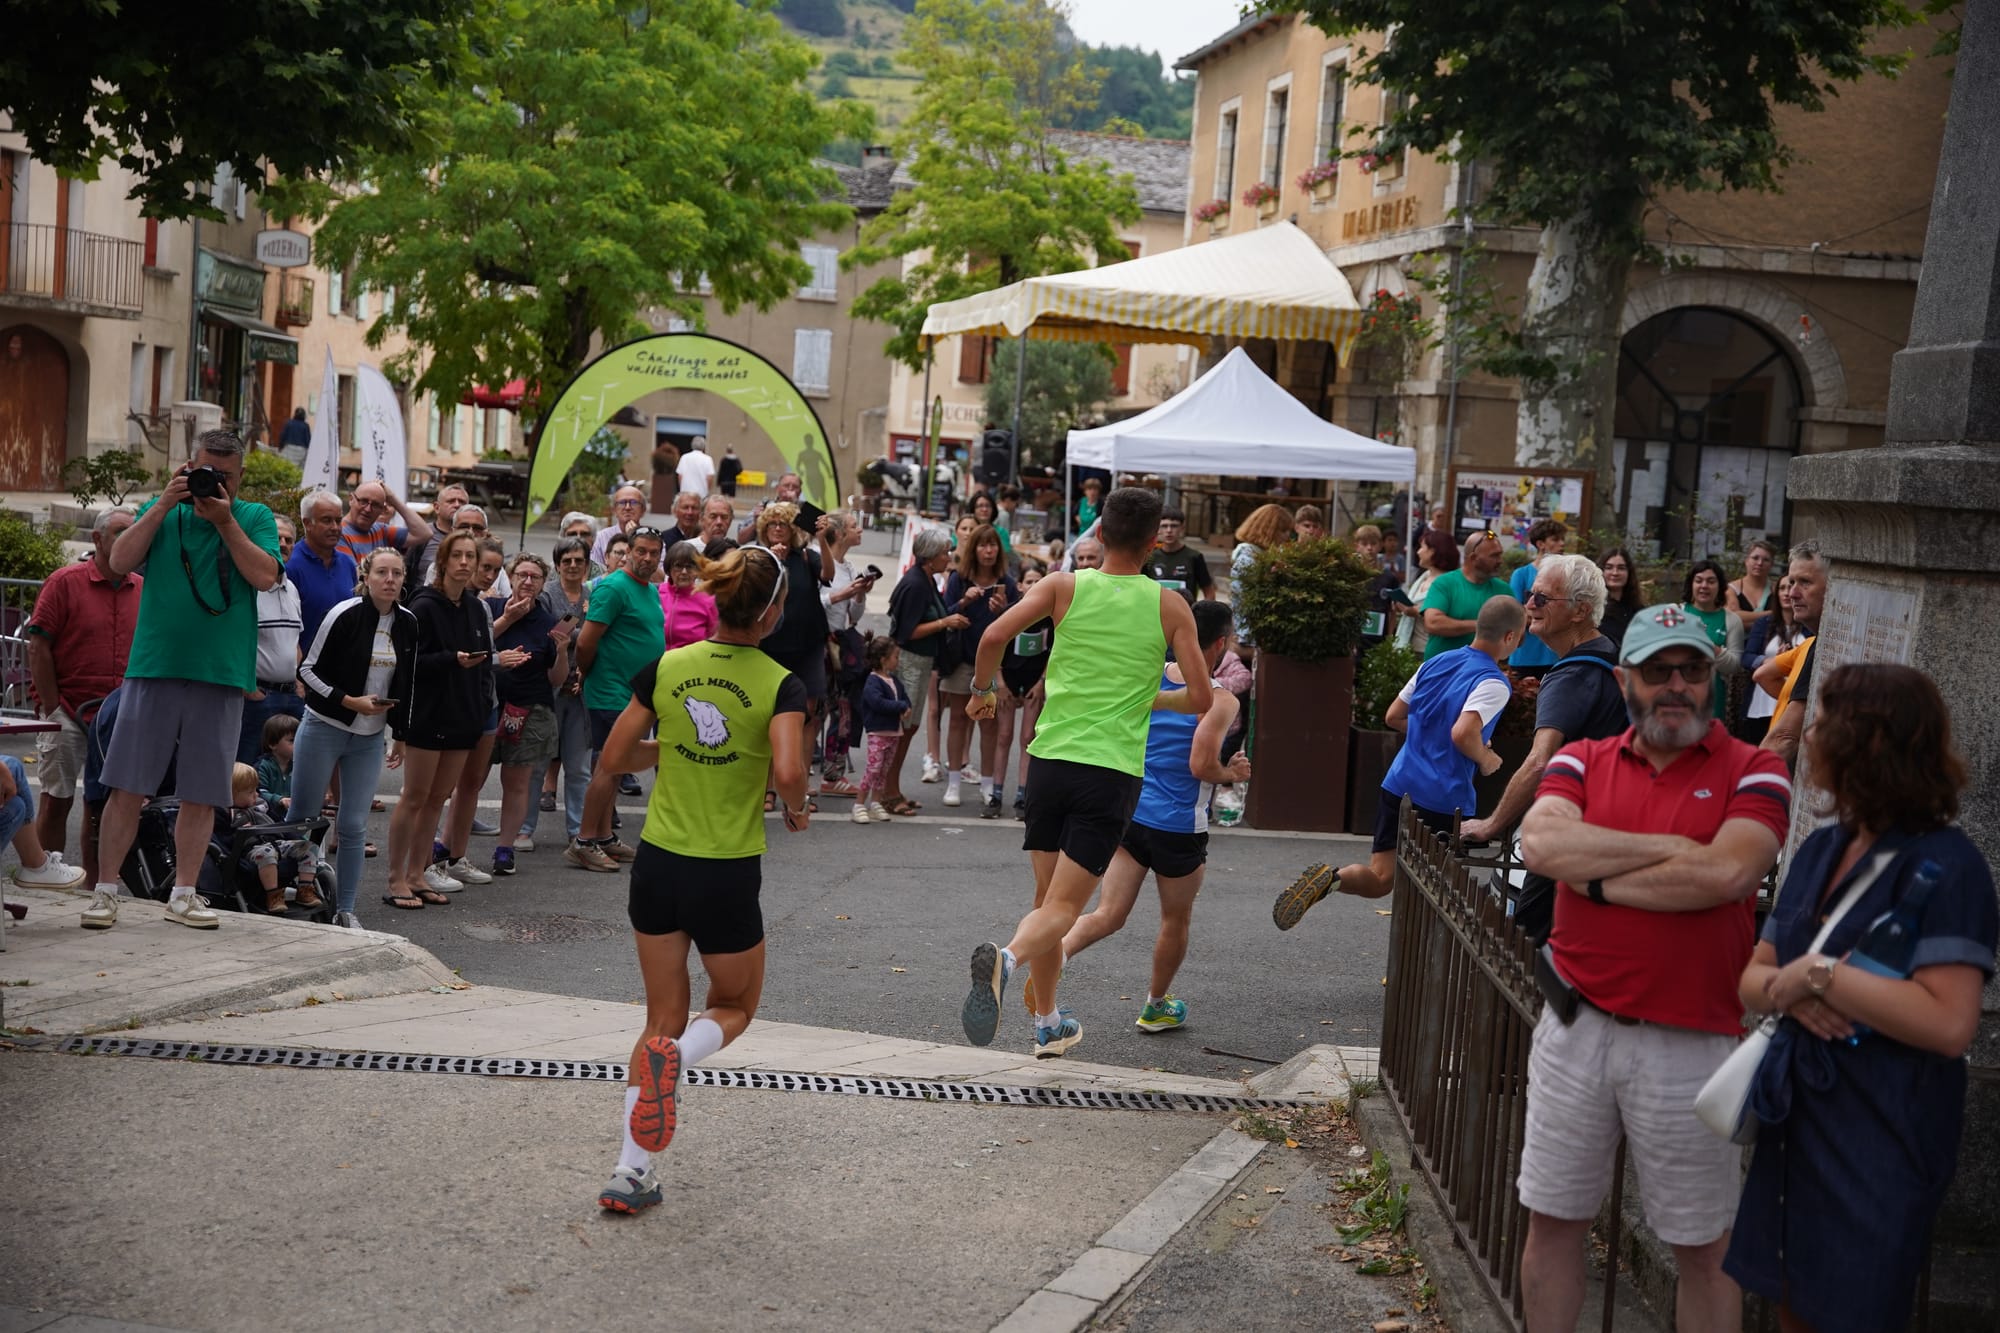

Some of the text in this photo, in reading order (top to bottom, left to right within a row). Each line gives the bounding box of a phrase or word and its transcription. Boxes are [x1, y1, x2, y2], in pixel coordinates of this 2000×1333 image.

[1342, 195, 1417, 239] MAIRIE
[262, 239, 304, 259] PIZZERIA
[636, 350, 741, 369] Challenge des
[626, 364, 678, 377] vallées
[1028, 641, 1037, 650] 2
[671, 677, 753, 708] ÉVEIL MENDOIS
[674, 743, 740, 766] ATHLÉTISME
